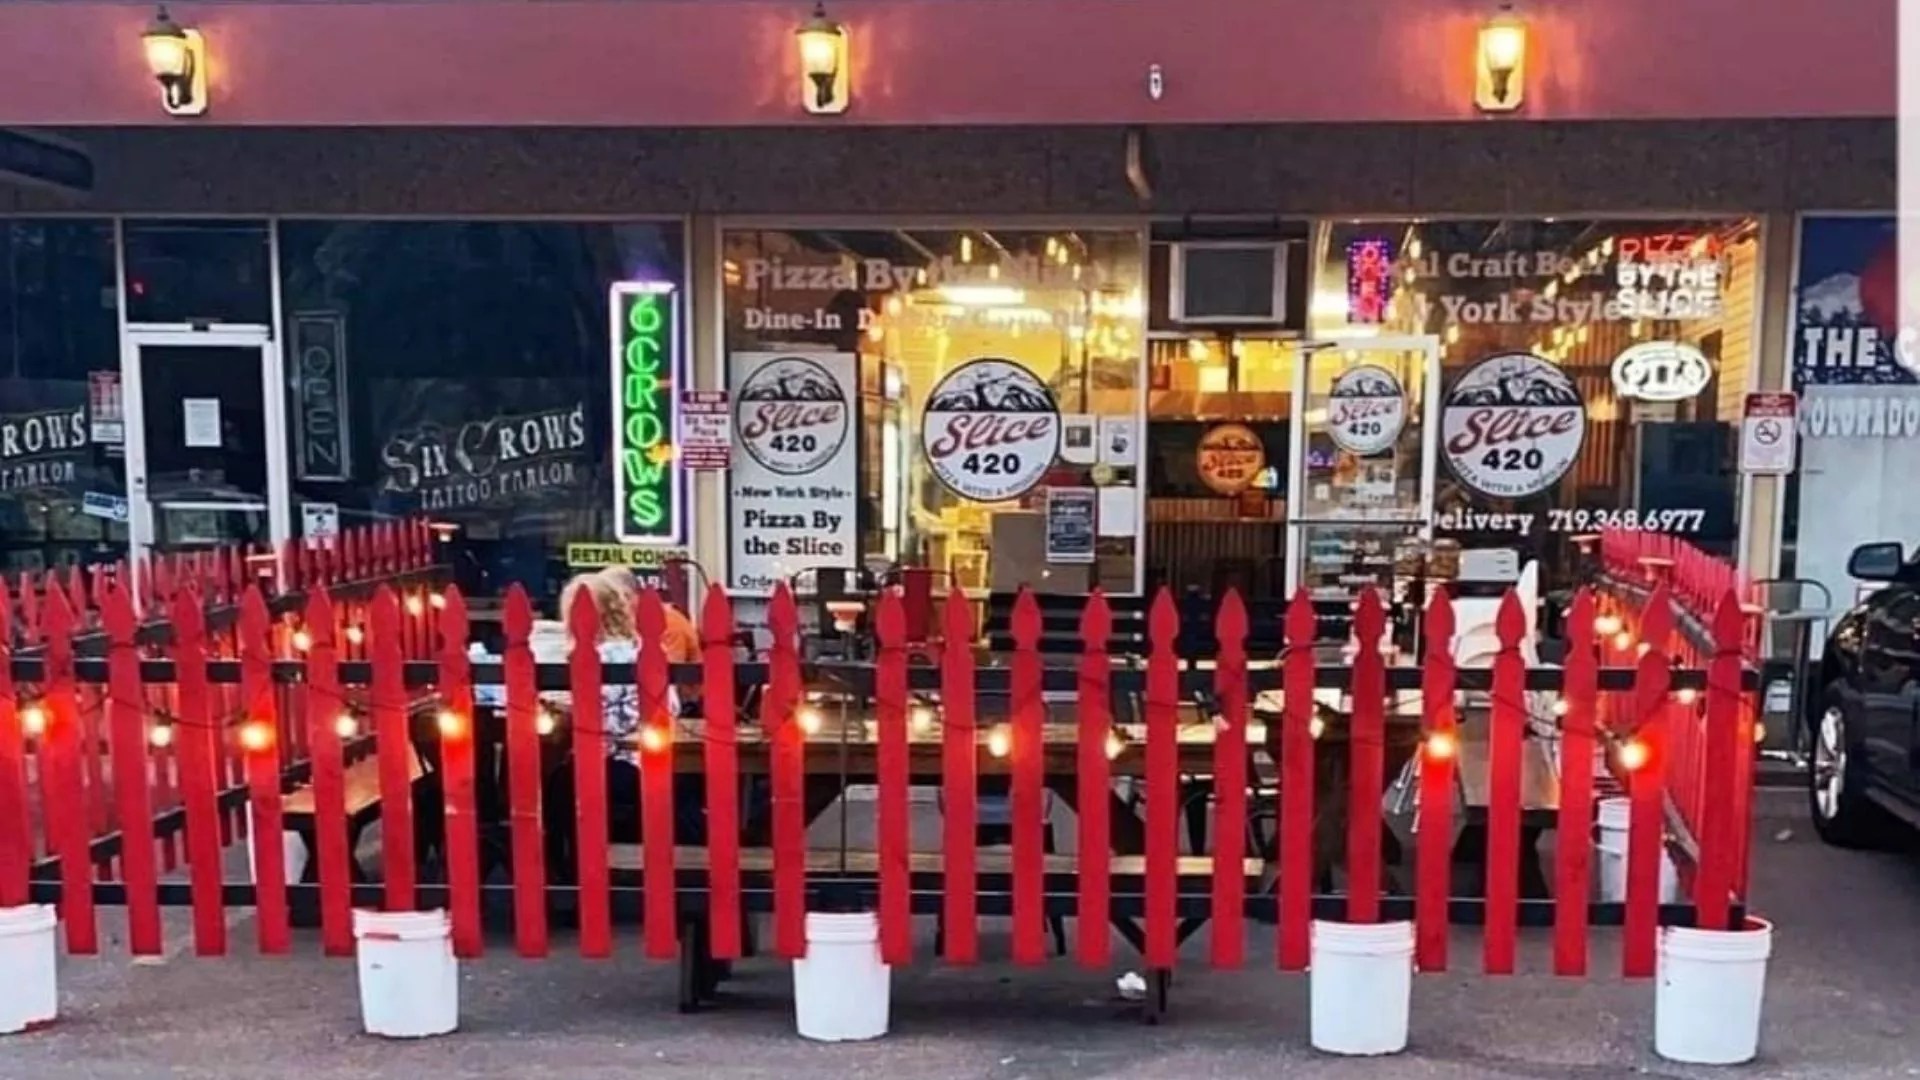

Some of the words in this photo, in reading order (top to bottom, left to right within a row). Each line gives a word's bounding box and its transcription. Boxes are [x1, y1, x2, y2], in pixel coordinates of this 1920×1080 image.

[745, 257, 858, 291] Pizza
[864, 257, 913, 296] By
[1447, 251, 1529, 278] Craft
[744, 307, 842, 330] Dine-In
[1440, 293, 1527, 324] York
[1530, 290, 1622, 330] Style
[1804, 327, 1878, 367] THE
[303, 347, 337, 466] OPEN
[744, 403, 841, 438] Slice
[1348, 423, 1382, 436] 420
[1448, 409, 1577, 455] Slice
[455, 402, 585, 478] CROWS
[770, 434, 817, 453] 420
[931, 413, 1052, 459] Slice
[962, 453, 1021, 475] 420
[1481, 448, 1544, 471] 420
[421, 479, 491, 510] TATTOO
[500, 462, 576, 495] PARLOR
[741, 486, 773, 498] New
[776, 486, 806, 498] York
[810, 485, 845, 501] Style
[743, 509, 806, 529] Pizza
[812, 510, 842, 534] By
[1548, 508, 1705, 532] 719.368.6977
[571, 548, 627, 563] RETAIL
[743, 535, 780, 555] the
[785, 536, 843, 555] Slice
